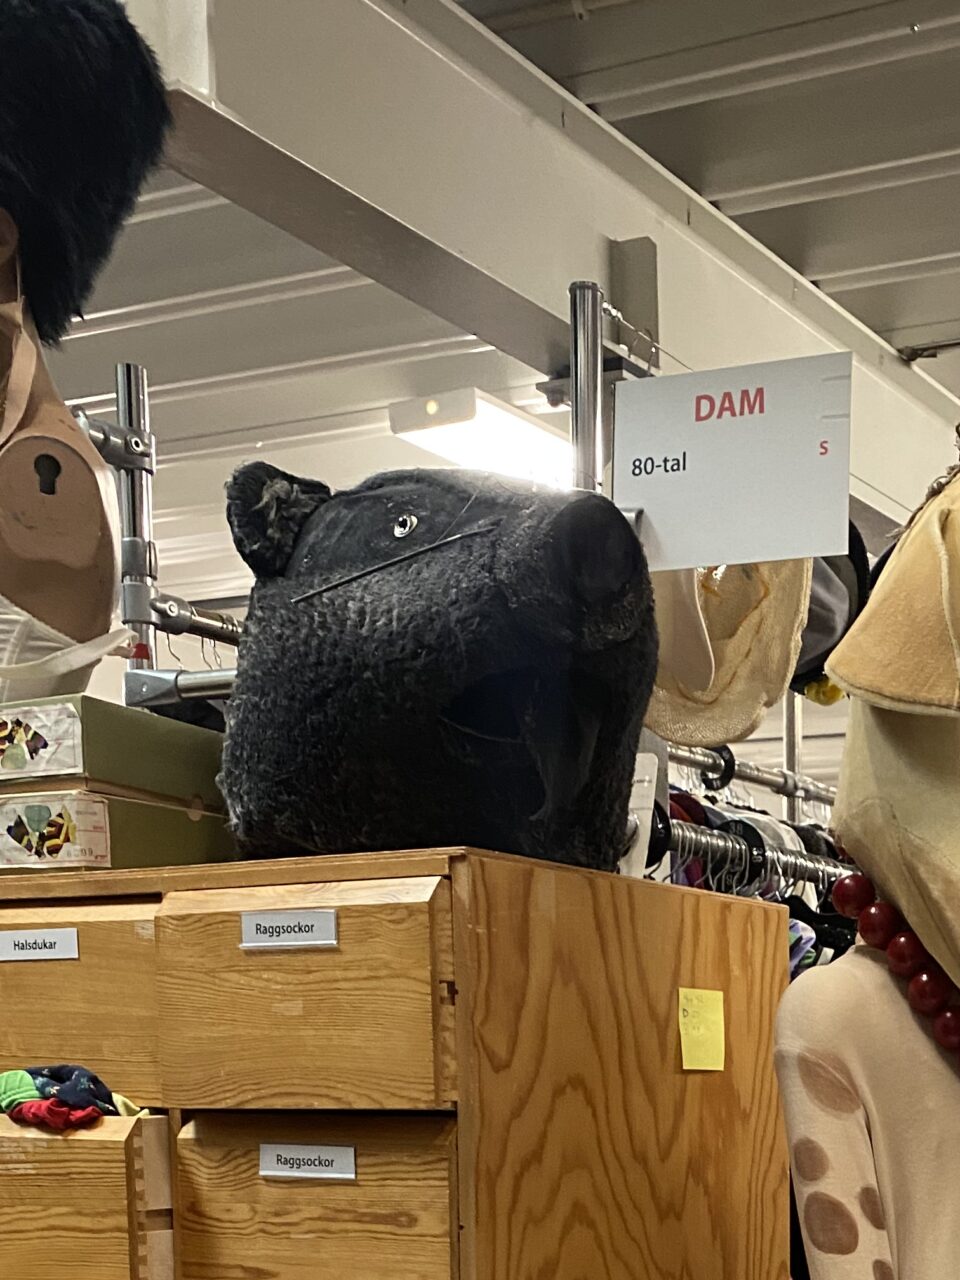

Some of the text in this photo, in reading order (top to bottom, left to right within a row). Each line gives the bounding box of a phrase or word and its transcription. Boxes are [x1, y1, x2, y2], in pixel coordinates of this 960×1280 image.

[694, 386, 766, 423] DAM
[631, 451, 687, 477] 80-tal
[255, 921, 315, 938] Raggsockor
[13, 939, 57, 951] Halsdukar
[276, 1153, 335, 1169] Raggsockor
